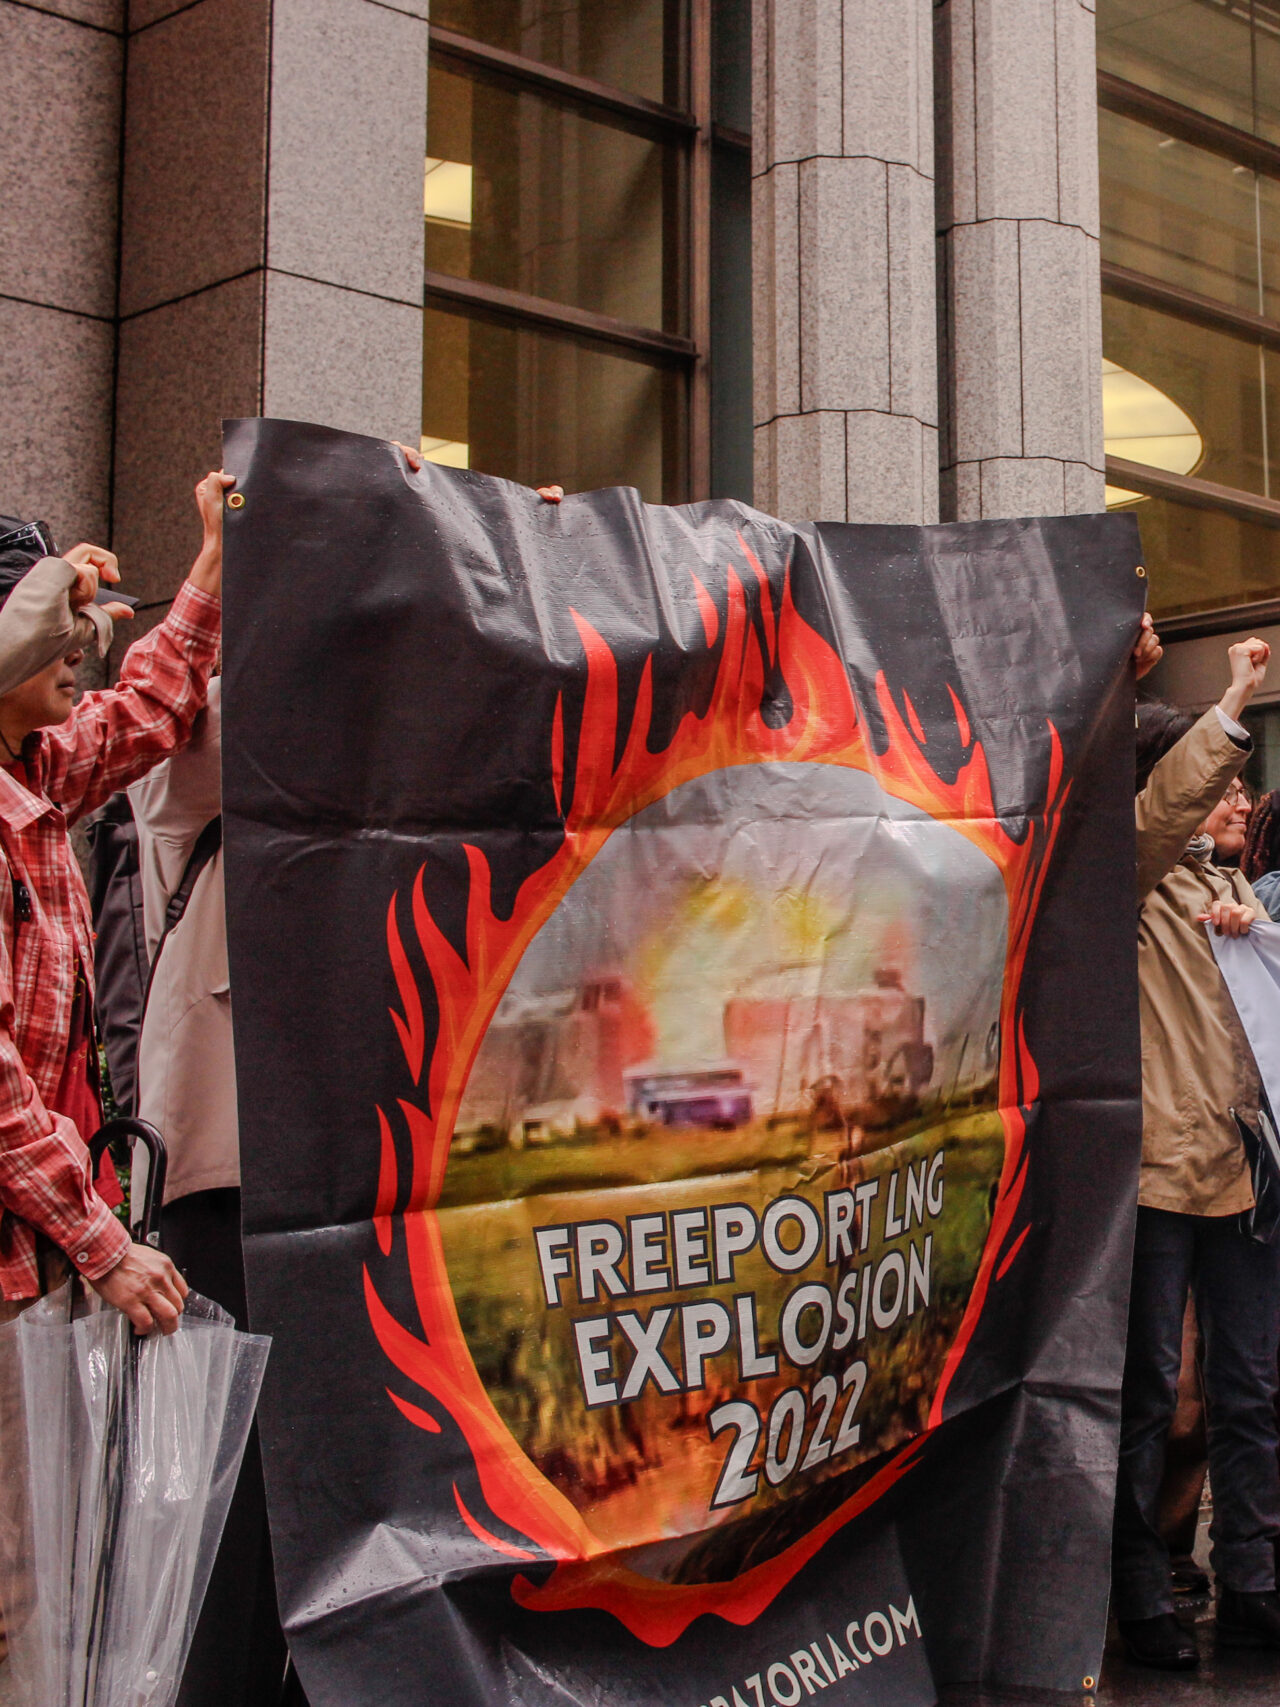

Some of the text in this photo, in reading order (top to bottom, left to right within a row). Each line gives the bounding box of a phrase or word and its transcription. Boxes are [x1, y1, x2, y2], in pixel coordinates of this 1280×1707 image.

[533, 1146, 945, 1309] FREEPORT LNG
[571, 1231, 933, 1411] EXPLOSION
[707, 1360, 868, 1511] 2022
[700, 1594, 922, 1707] ZORIA.COM
